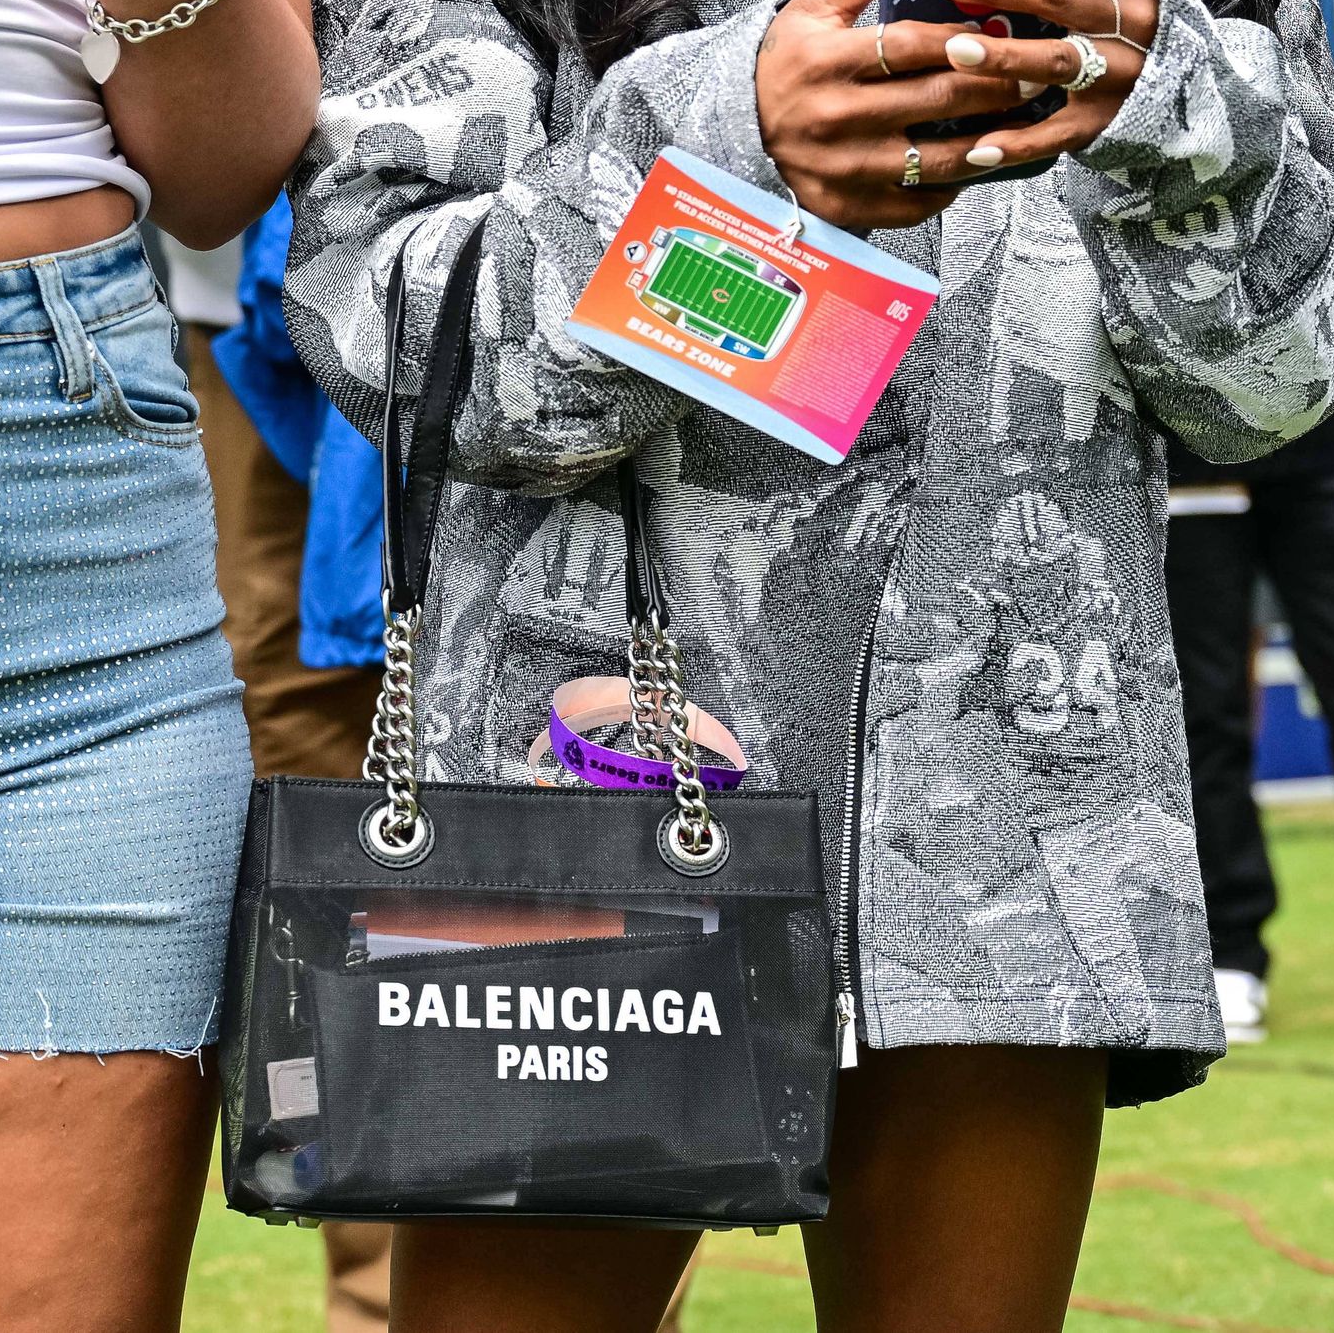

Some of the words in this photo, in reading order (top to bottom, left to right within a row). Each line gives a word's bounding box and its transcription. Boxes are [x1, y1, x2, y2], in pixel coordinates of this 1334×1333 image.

[356, 52, 474, 110] OWENS
[663, 184, 678, 196] NO
[677, 186, 714, 213] STADIUM
[712, 204, 742, 229] ACCESS
[740, 219, 779, 246] WITHOUT
[801, 250, 830, 271] TICKET
[674, 200, 698, 218] FIELD
[696, 211, 726, 233] ACCESS
[725, 224, 765, 250] WEATHER
[763, 243, 812, 275] PERMITTING
[773, 274, 787, 286] SE
[653, 302, 671, 316] NW
[886, 299, 913, 323] 005
[625, 317, 688, 354] BEARS
[685, 345, 737, 379] ZONE
[733, 341, 751, 355] SW
[588, 758, 640, 784] Bears
[376, 980, 722, 1037] BALENCIAGA
[496, 1043, 609, 1082] PARIS
